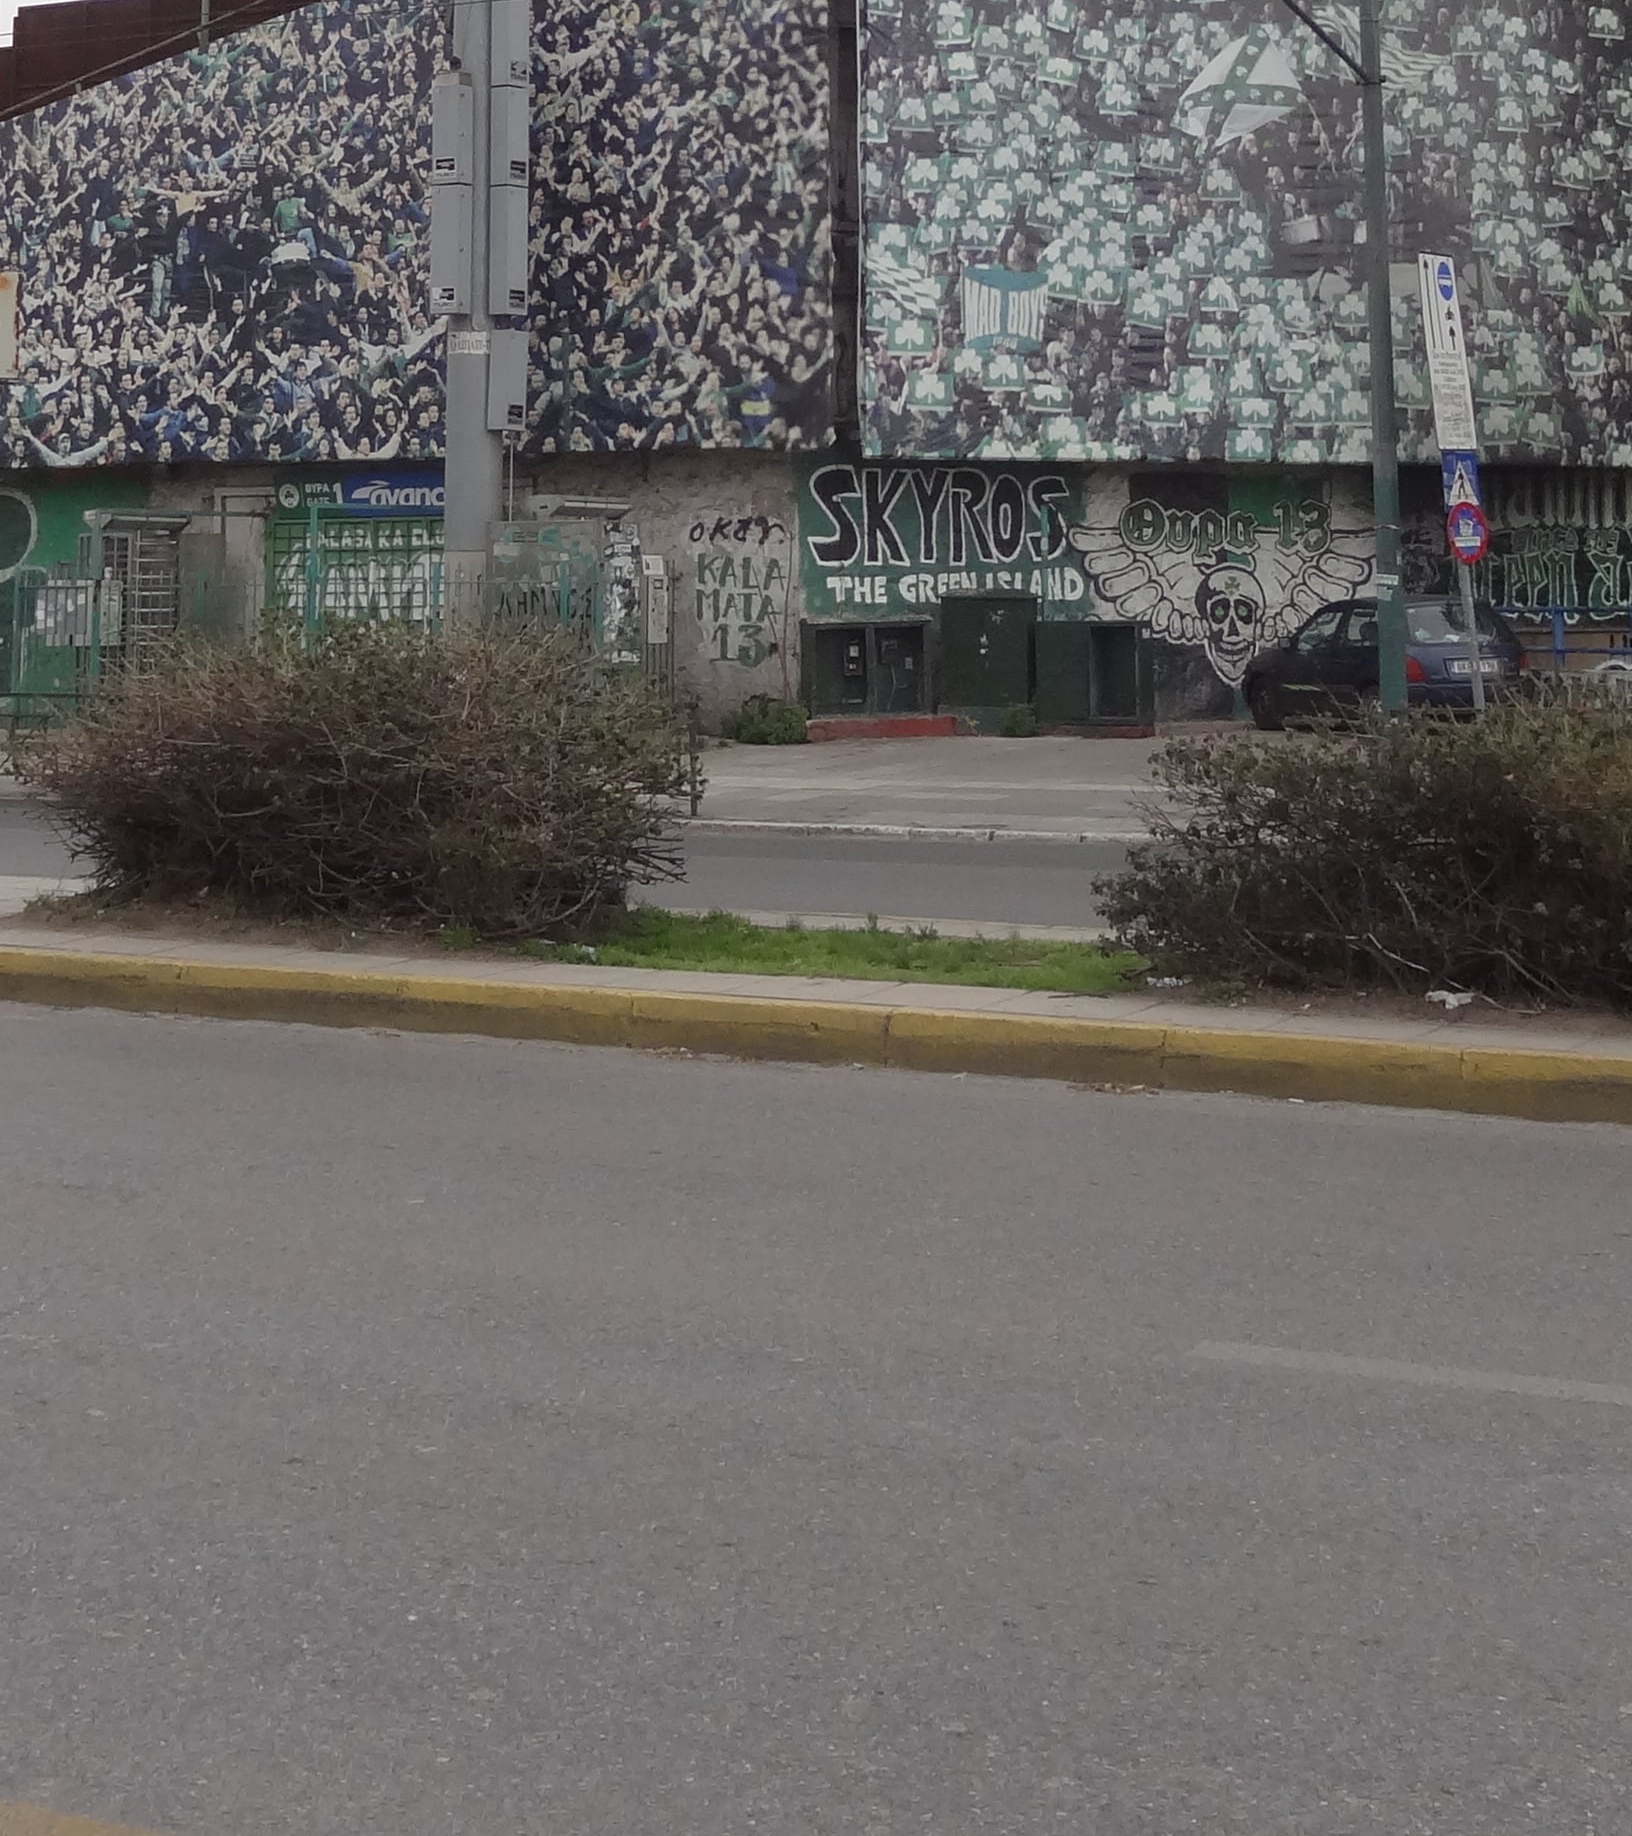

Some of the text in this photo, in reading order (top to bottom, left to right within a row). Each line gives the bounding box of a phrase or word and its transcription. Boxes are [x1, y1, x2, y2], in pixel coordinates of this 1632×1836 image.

[371, 486, 446, 506] avanc
[807, 464, 1070, 567] SKYROS
[1273, 498, 1333, 558] 13
[697, 552, 786, 591] KALA
[826, 575, 888, 604] THE
[898, 570, 977, 604] GREEN
[697, 588, 782, 622] MATA
[710, 623, 768, 668] 13
